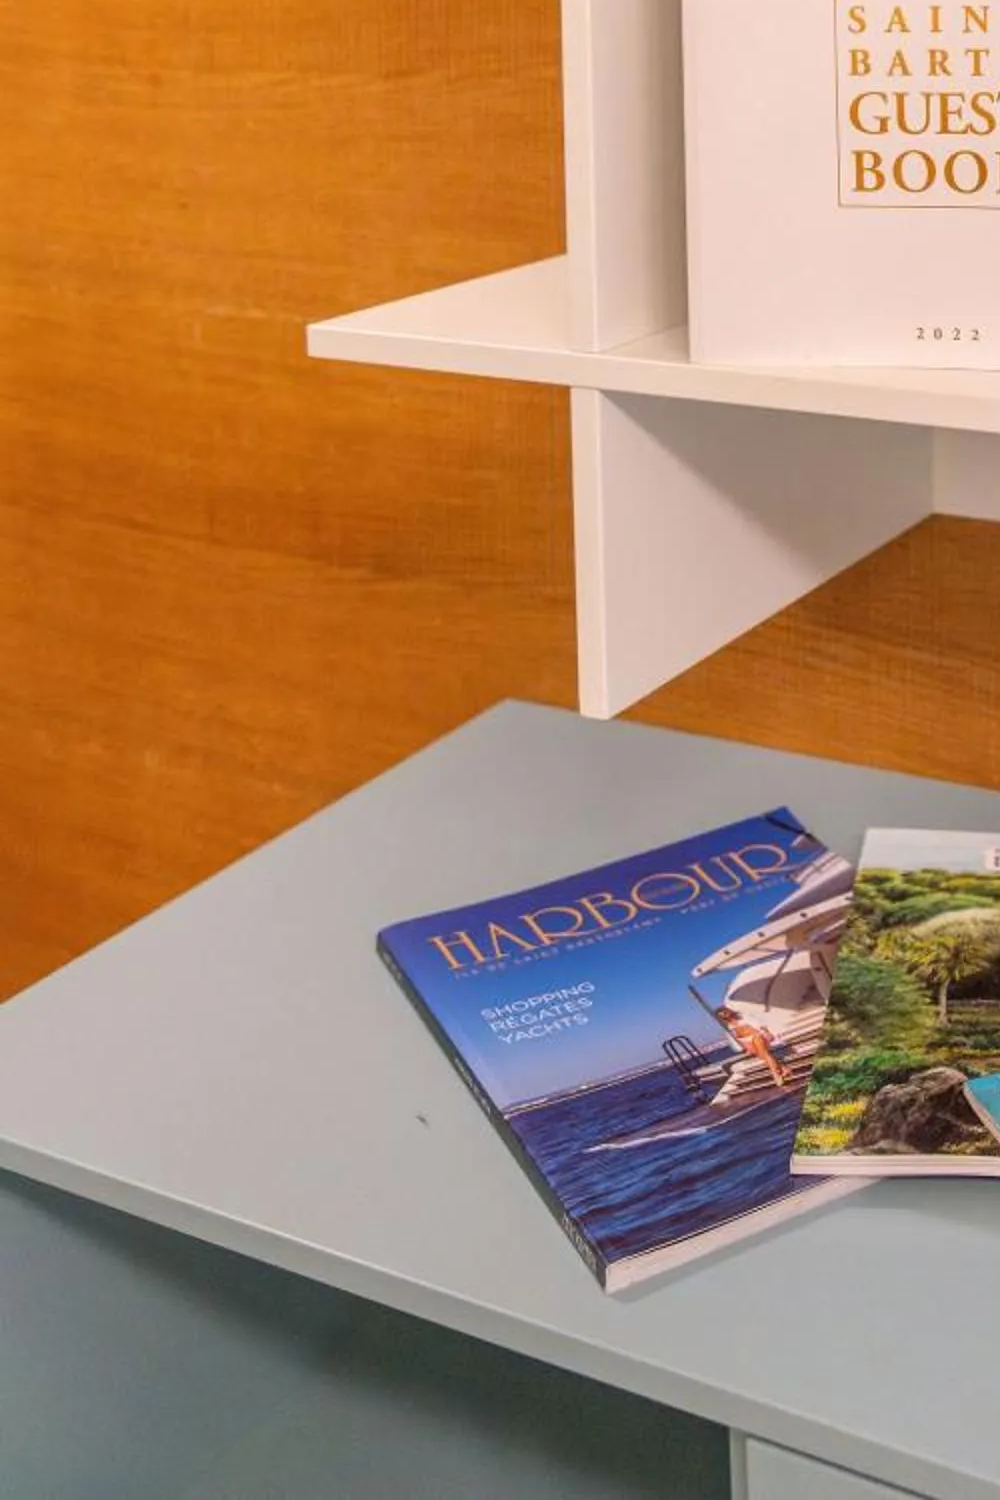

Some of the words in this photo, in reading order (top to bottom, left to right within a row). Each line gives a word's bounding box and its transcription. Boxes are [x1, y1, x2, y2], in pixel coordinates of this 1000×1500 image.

[915, 327, 981, 341] 2022
[428, 842, 803, 970] HARBOUR
[481, 981, 596, 1020] SHOPPING
[498, 1013, 590, 1044] YACHTS
